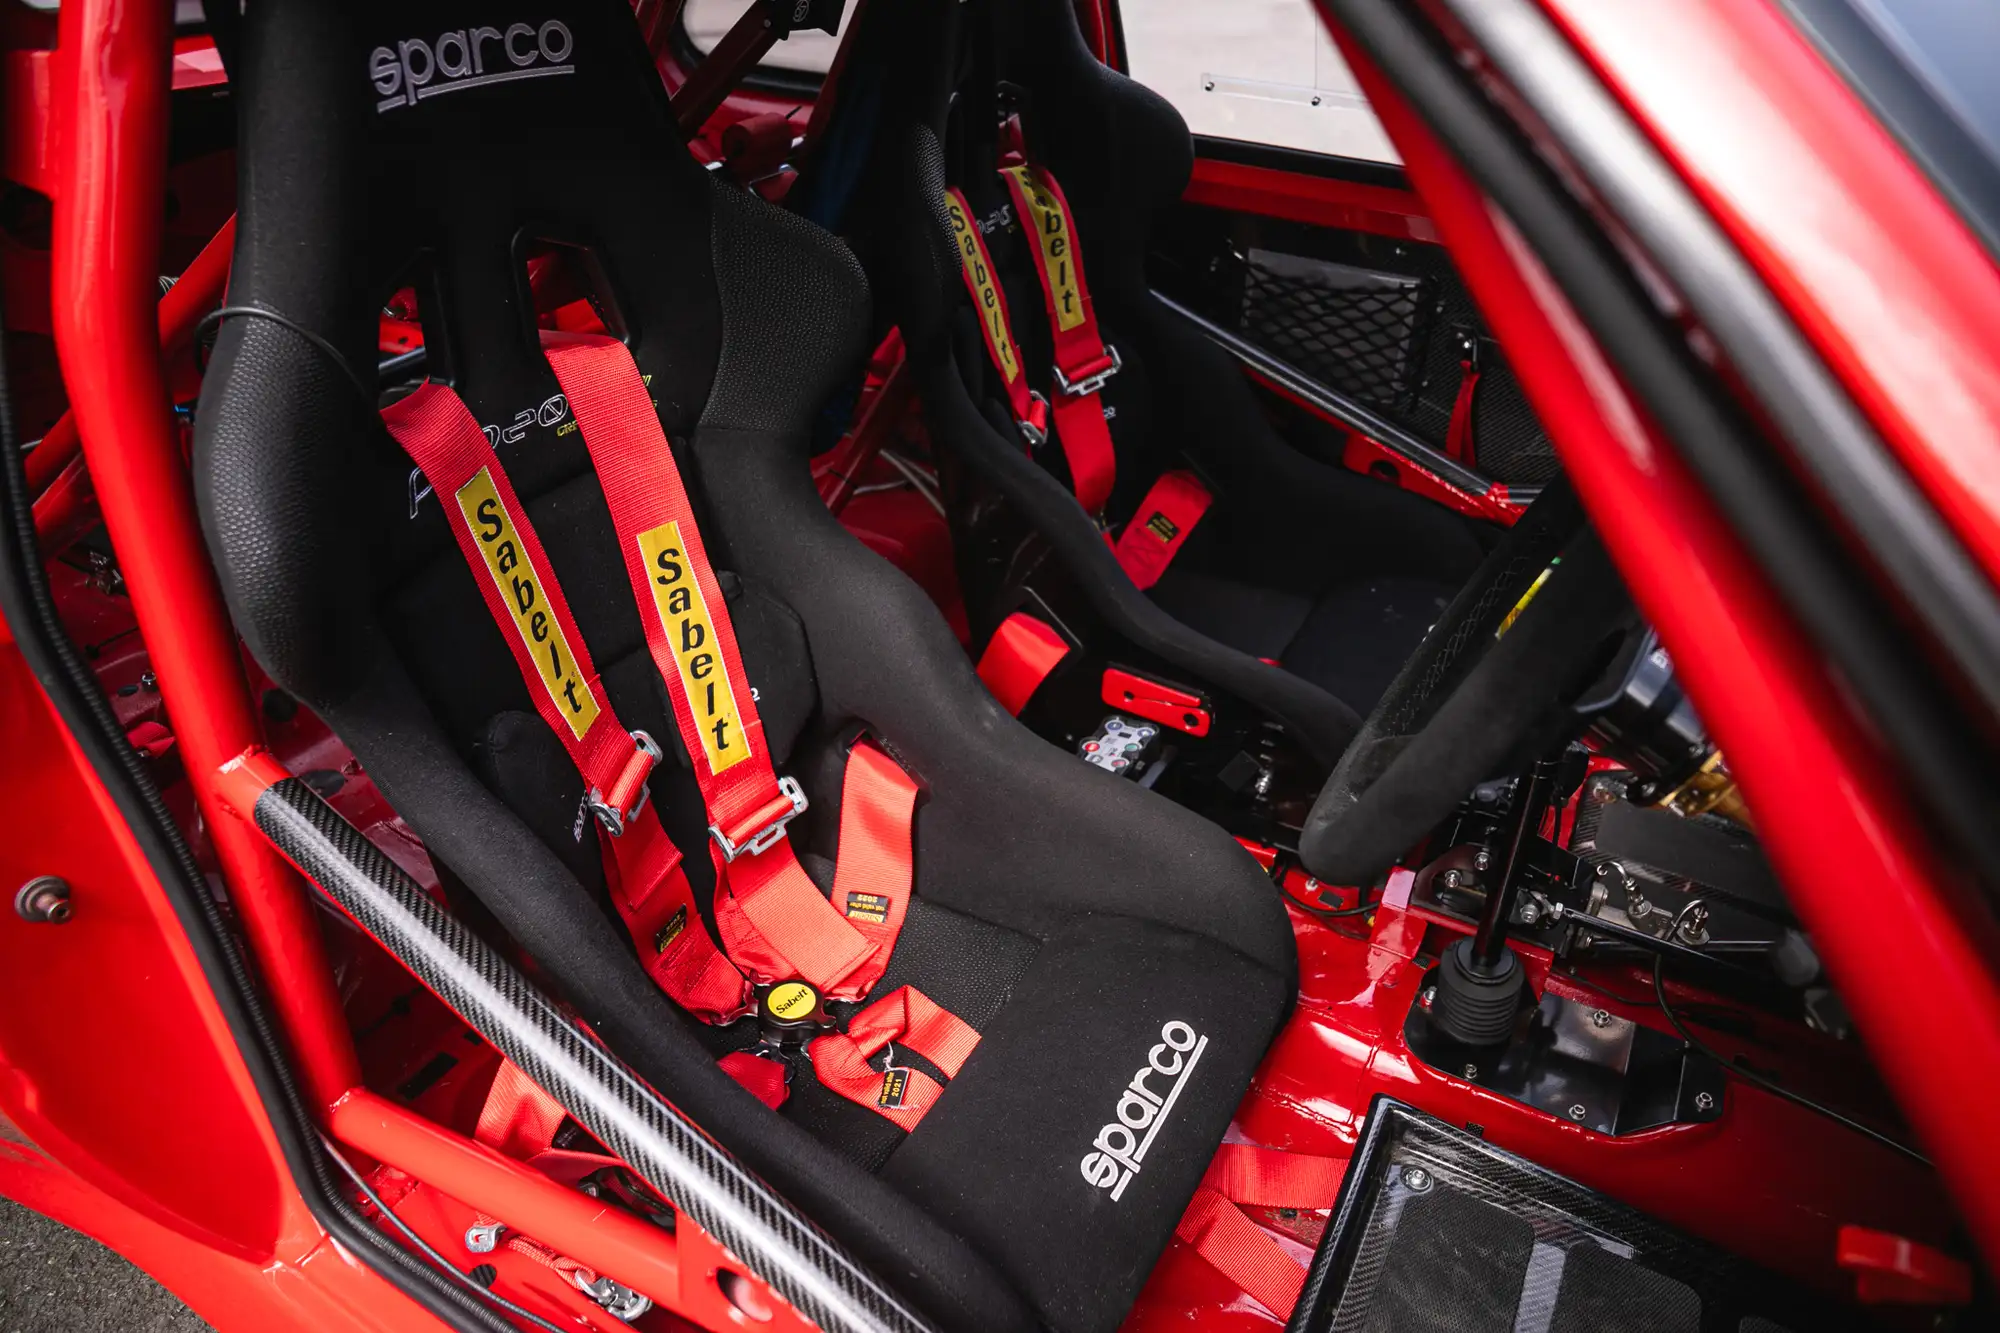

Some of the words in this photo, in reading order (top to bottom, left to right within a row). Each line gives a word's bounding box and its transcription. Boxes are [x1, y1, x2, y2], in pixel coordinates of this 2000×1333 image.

[370, 19, 574, 108] sparco
[949, 205, 1011, 365] Sabelt
[476, 498, 582, 714] Sabelt
[656, 547, 729, 751] Sabelt
[775, 987, 808, 1014] Sabelt
[891, 1078, 903, 1098] 2021
[1080, 1020, 1197, 1188] sparco
